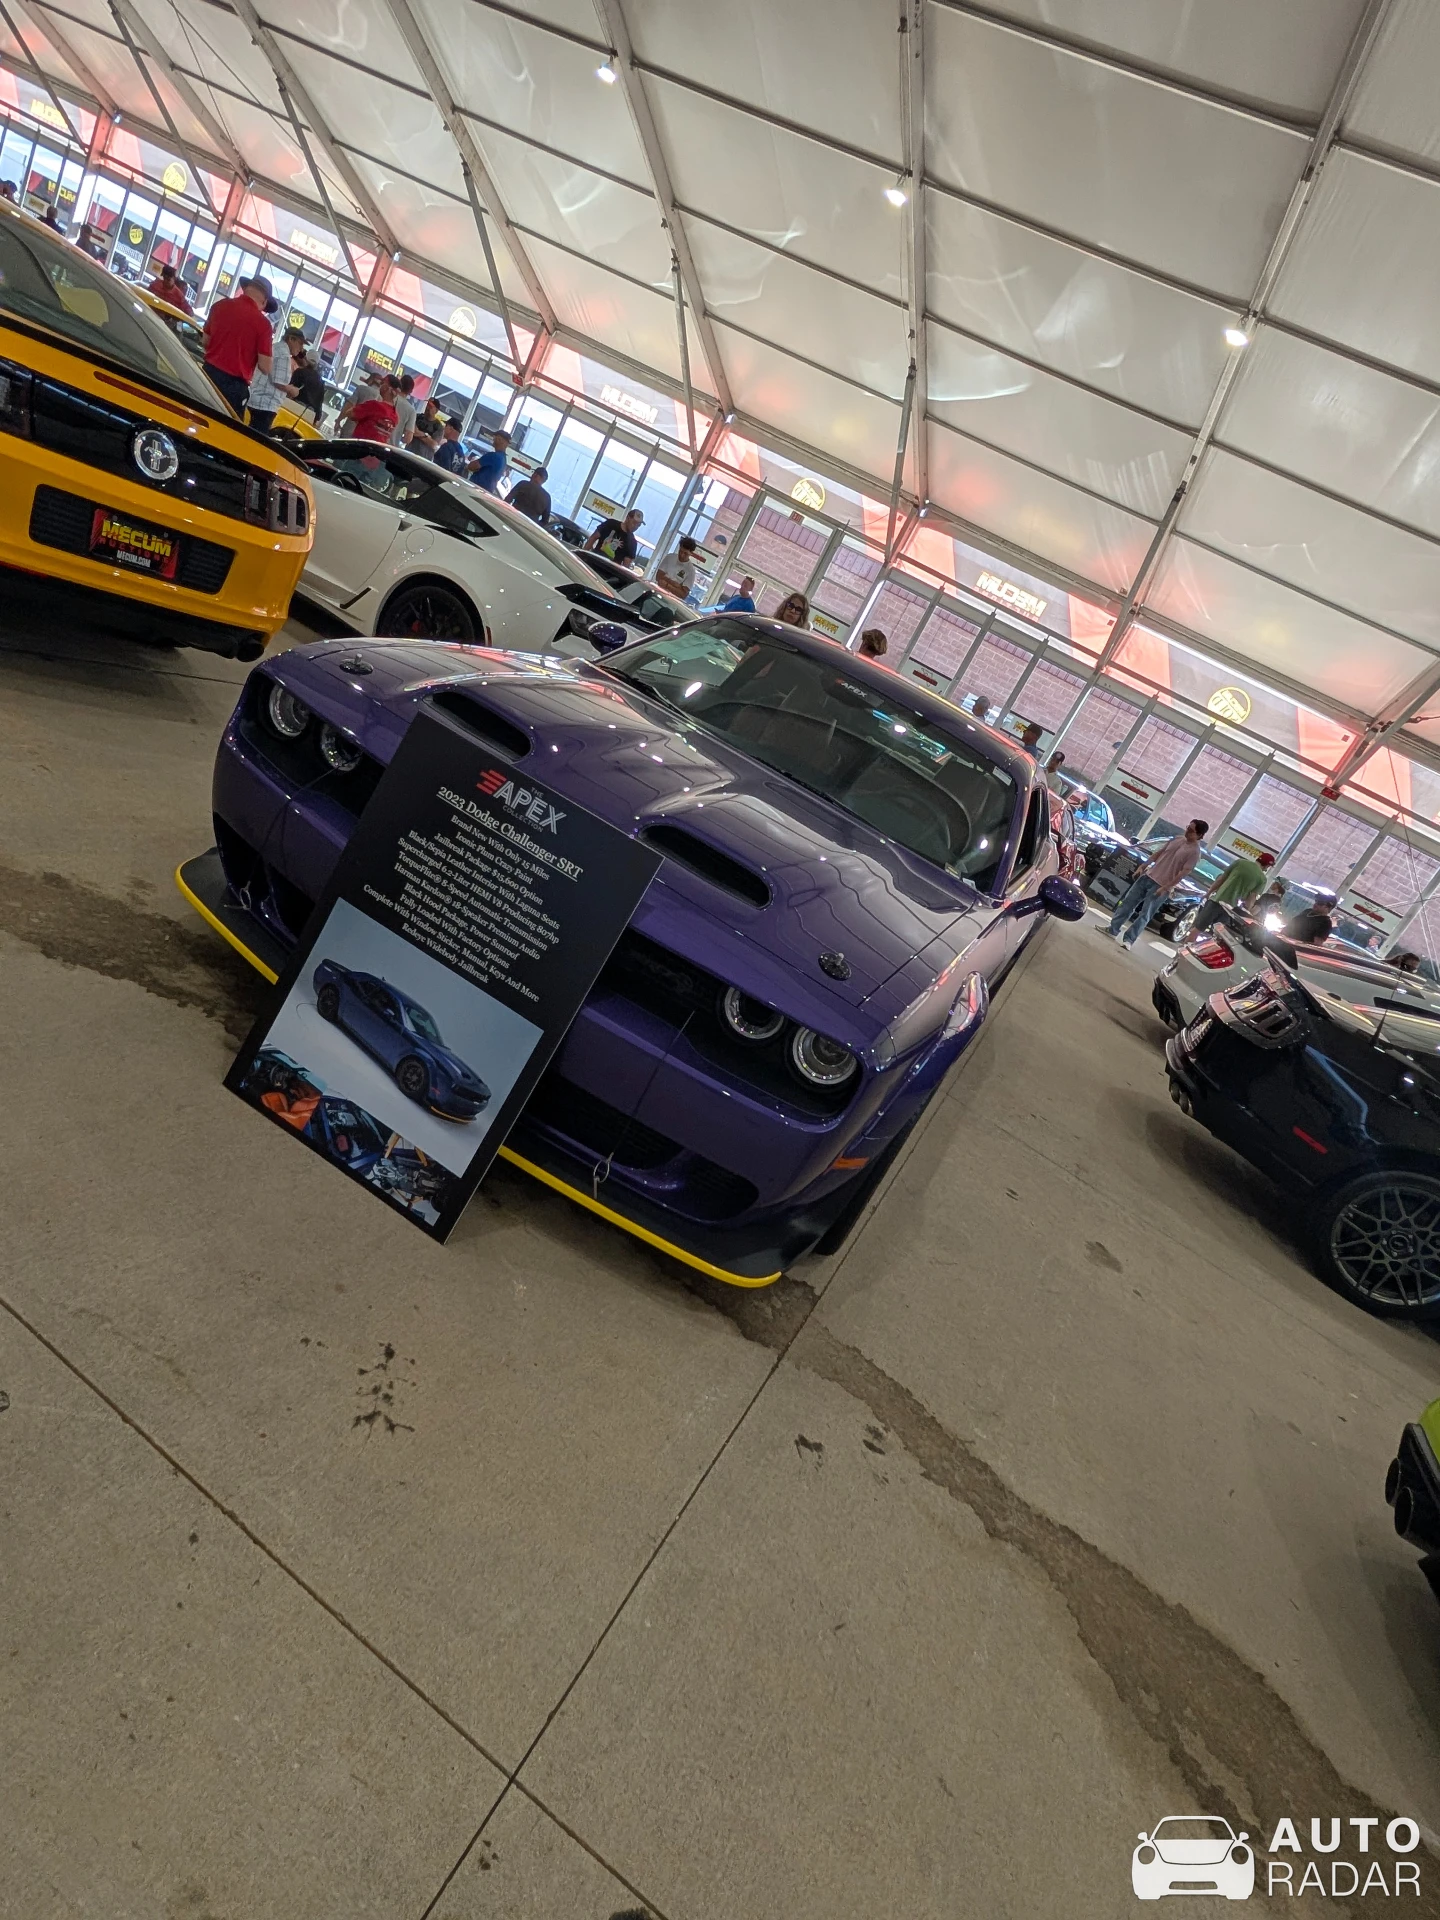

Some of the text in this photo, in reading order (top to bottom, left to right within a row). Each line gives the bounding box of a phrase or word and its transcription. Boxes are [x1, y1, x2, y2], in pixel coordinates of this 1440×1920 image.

[101, 519, 172, 557] MECUM
[116, 549, 151, 568] MECUM.COM
[492, 779, 567, 835] APEX
[502, 804, 544, 833] COLLECTION
[531, 786, 544, 799] THE
[437, 786, 584, 879] 2023 Dodge Challenger SRT
[450, 814, 551, 881] Brand New With Only 15 Miles
[455, 831, 534, 885] Iconic Plum Crazy Paint
[397, 837, 560, 945] Supercharged 6.2-Liter HEMI V8 Producing 807hp
[408, 829, 561, 930] Black/Sepia Leather Interior With Laguna Seats
[433, 832, 544, 906] Jailbreak Package $15,600 Option
[363, 884, 540, 1003] Complete With Window Sticker, Manual, Keys And More
[393, 862, 422, 885] Harman
[451, 900, 490, 927] 18-Speaker
[487, 922, 520, 948] Premium
[518, 943, 541, 960] Audio
[399, 893, 511, 969] Fully Loaded With Factory Options
[403, 882, 521, 961] Black Hood Package, Power Sunroof
[440, 879, 470, 901] 8-Speed
[467, 896, 504, 923] Automatic
[502, 917, 548, 951] Transmission
[401, 922, 490, 984] Redeye Widebody Jailbreak
